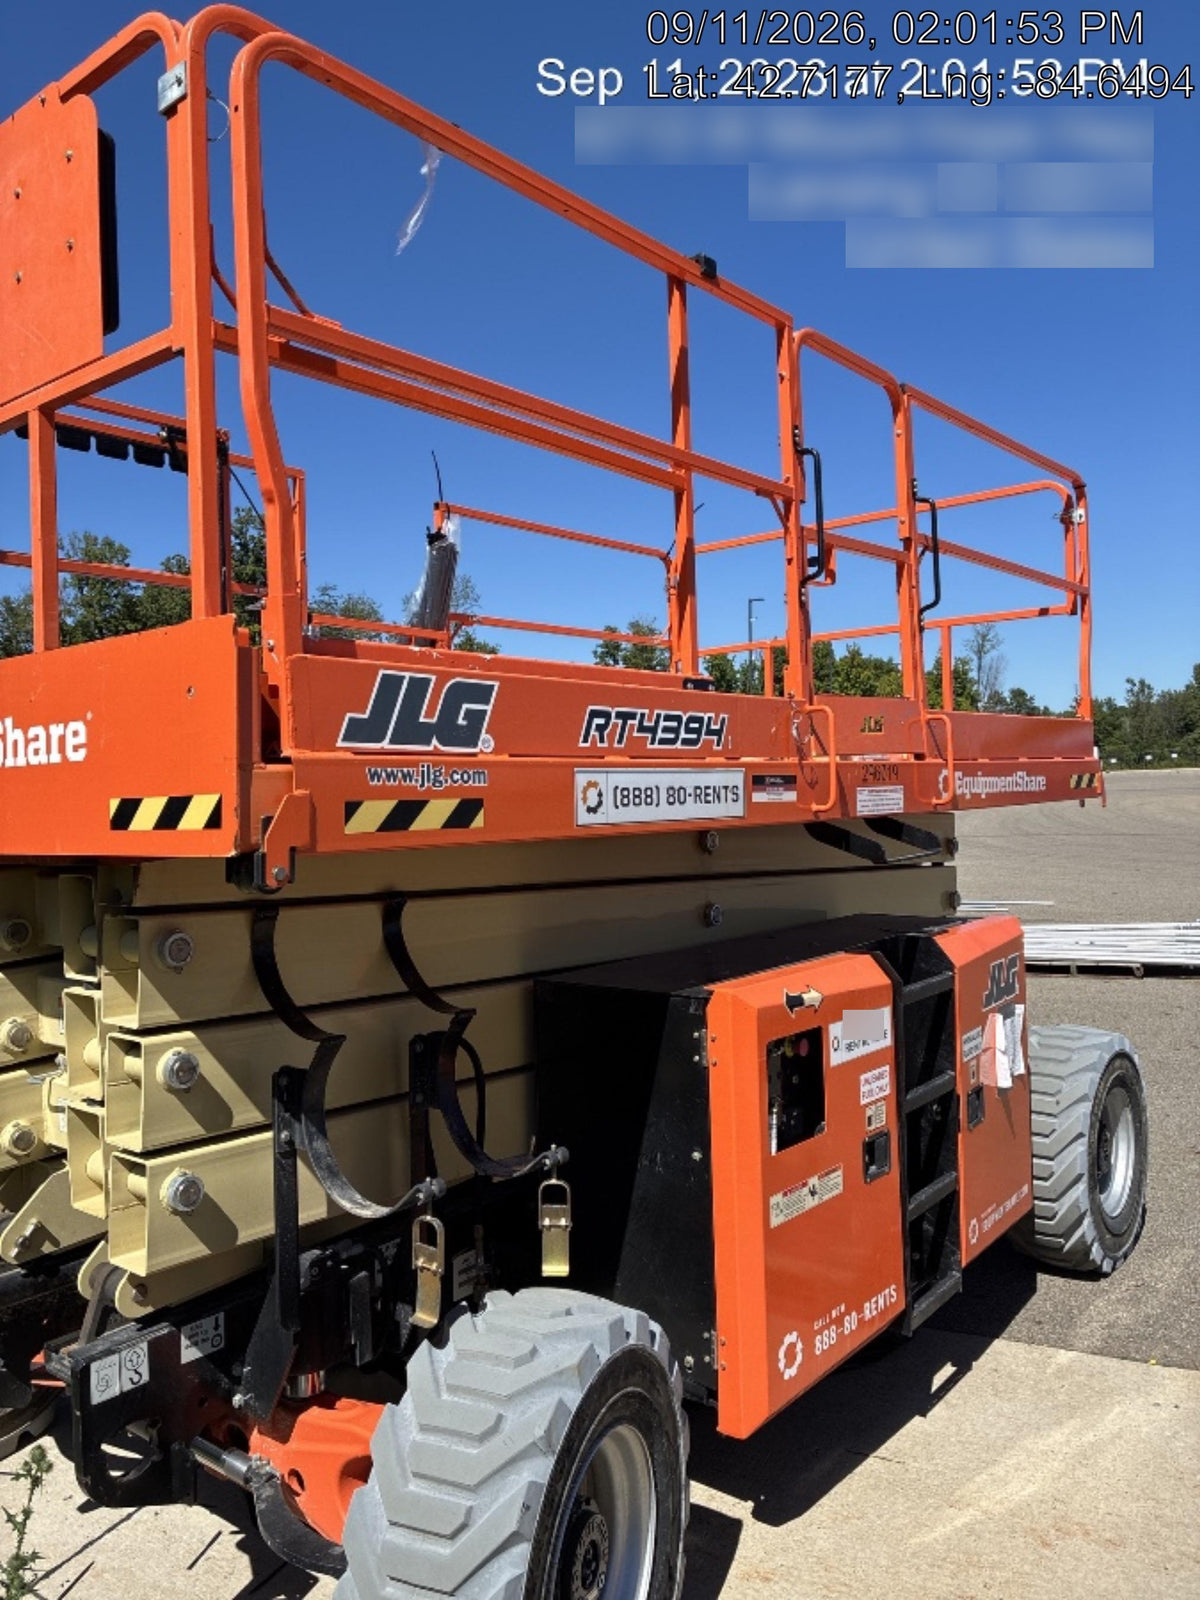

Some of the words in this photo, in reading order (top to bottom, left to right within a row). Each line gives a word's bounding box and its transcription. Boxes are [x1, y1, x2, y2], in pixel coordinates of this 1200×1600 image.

[336, 669, 500, 752] JLG
[578, 705, 729, 749] RT4394
[0, 716, 88, 768] hare
[366, 763, 488, 789] www.jlg.com
[613, 785, 660, 809] (888)
[666, 785, 740, 806] 80-RENTS
[954, 770, 1047, 799] EquipmentShare
[982, 952, 1020, 1012] JLG
[815, 1284, 897, 1356] 888-80-RENTS
